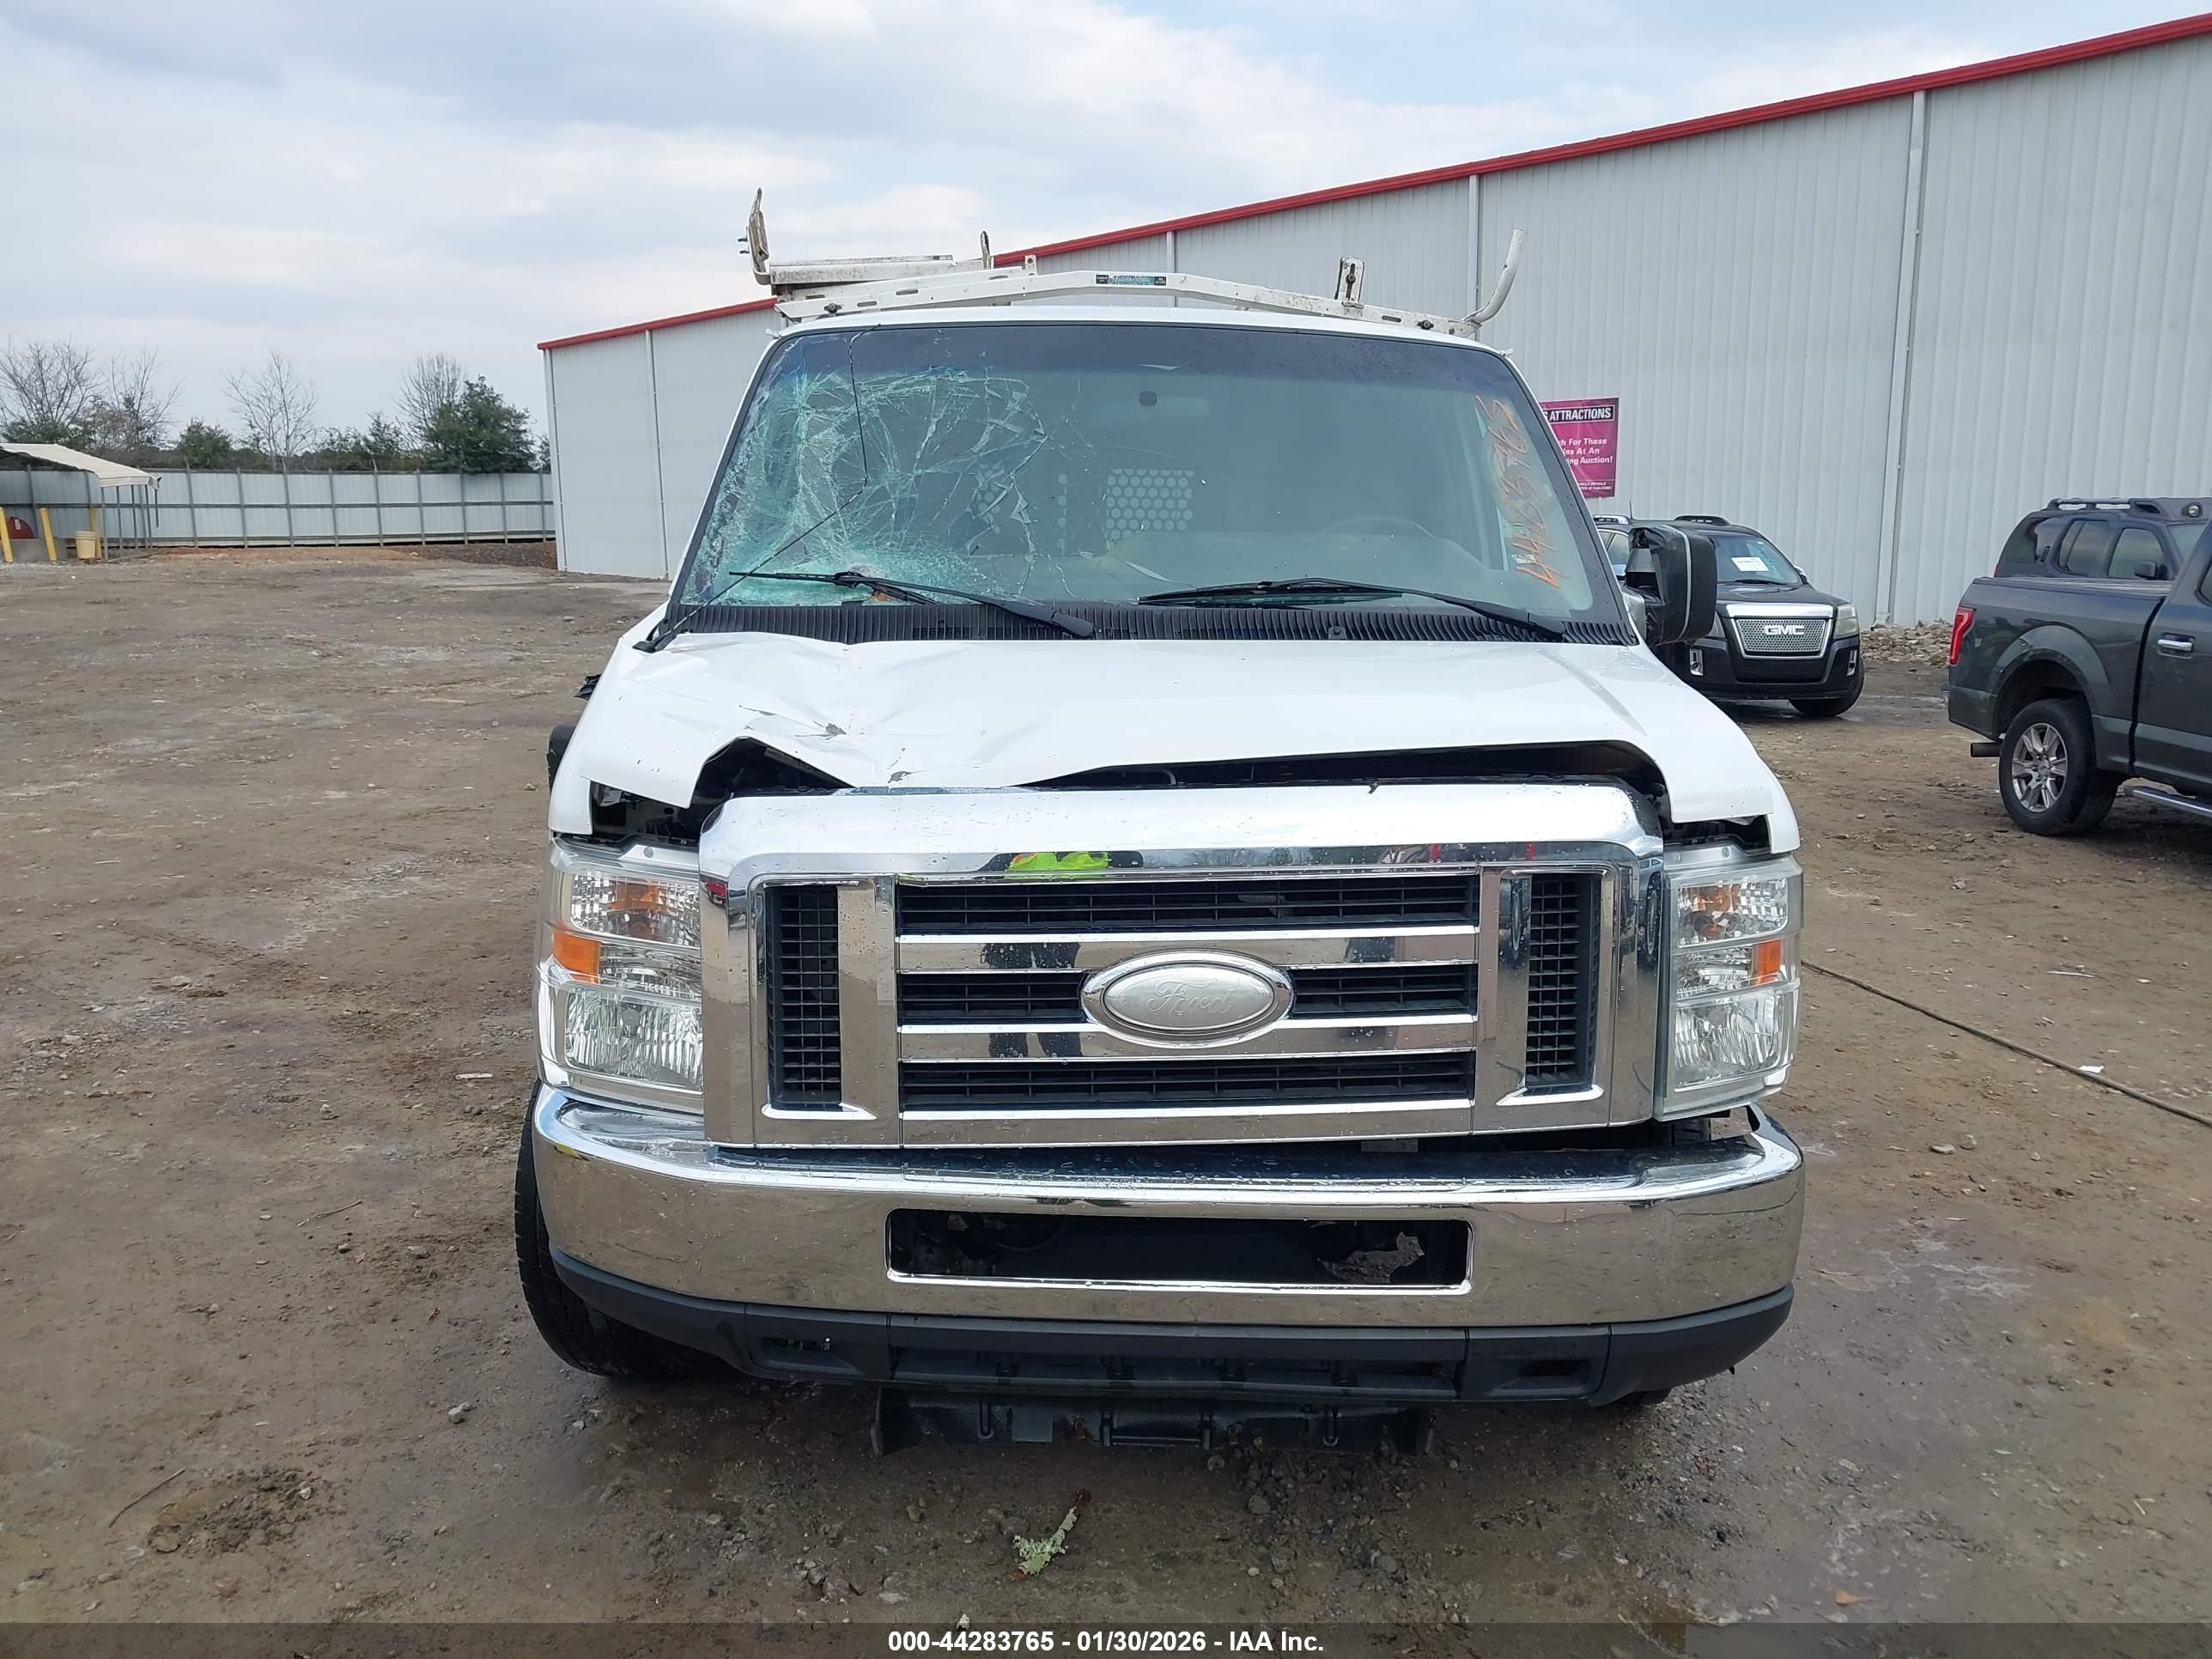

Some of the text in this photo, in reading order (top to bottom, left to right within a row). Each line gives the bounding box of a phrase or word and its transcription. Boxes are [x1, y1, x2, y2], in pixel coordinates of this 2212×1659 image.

[1549, 407, 1612, 422] ATTRACTIONS
[1580, 455, 1613, 465] Auction!
[1764, 625, 1805, 635] GMC
[1146, 980, 1235, 1016] Ford
